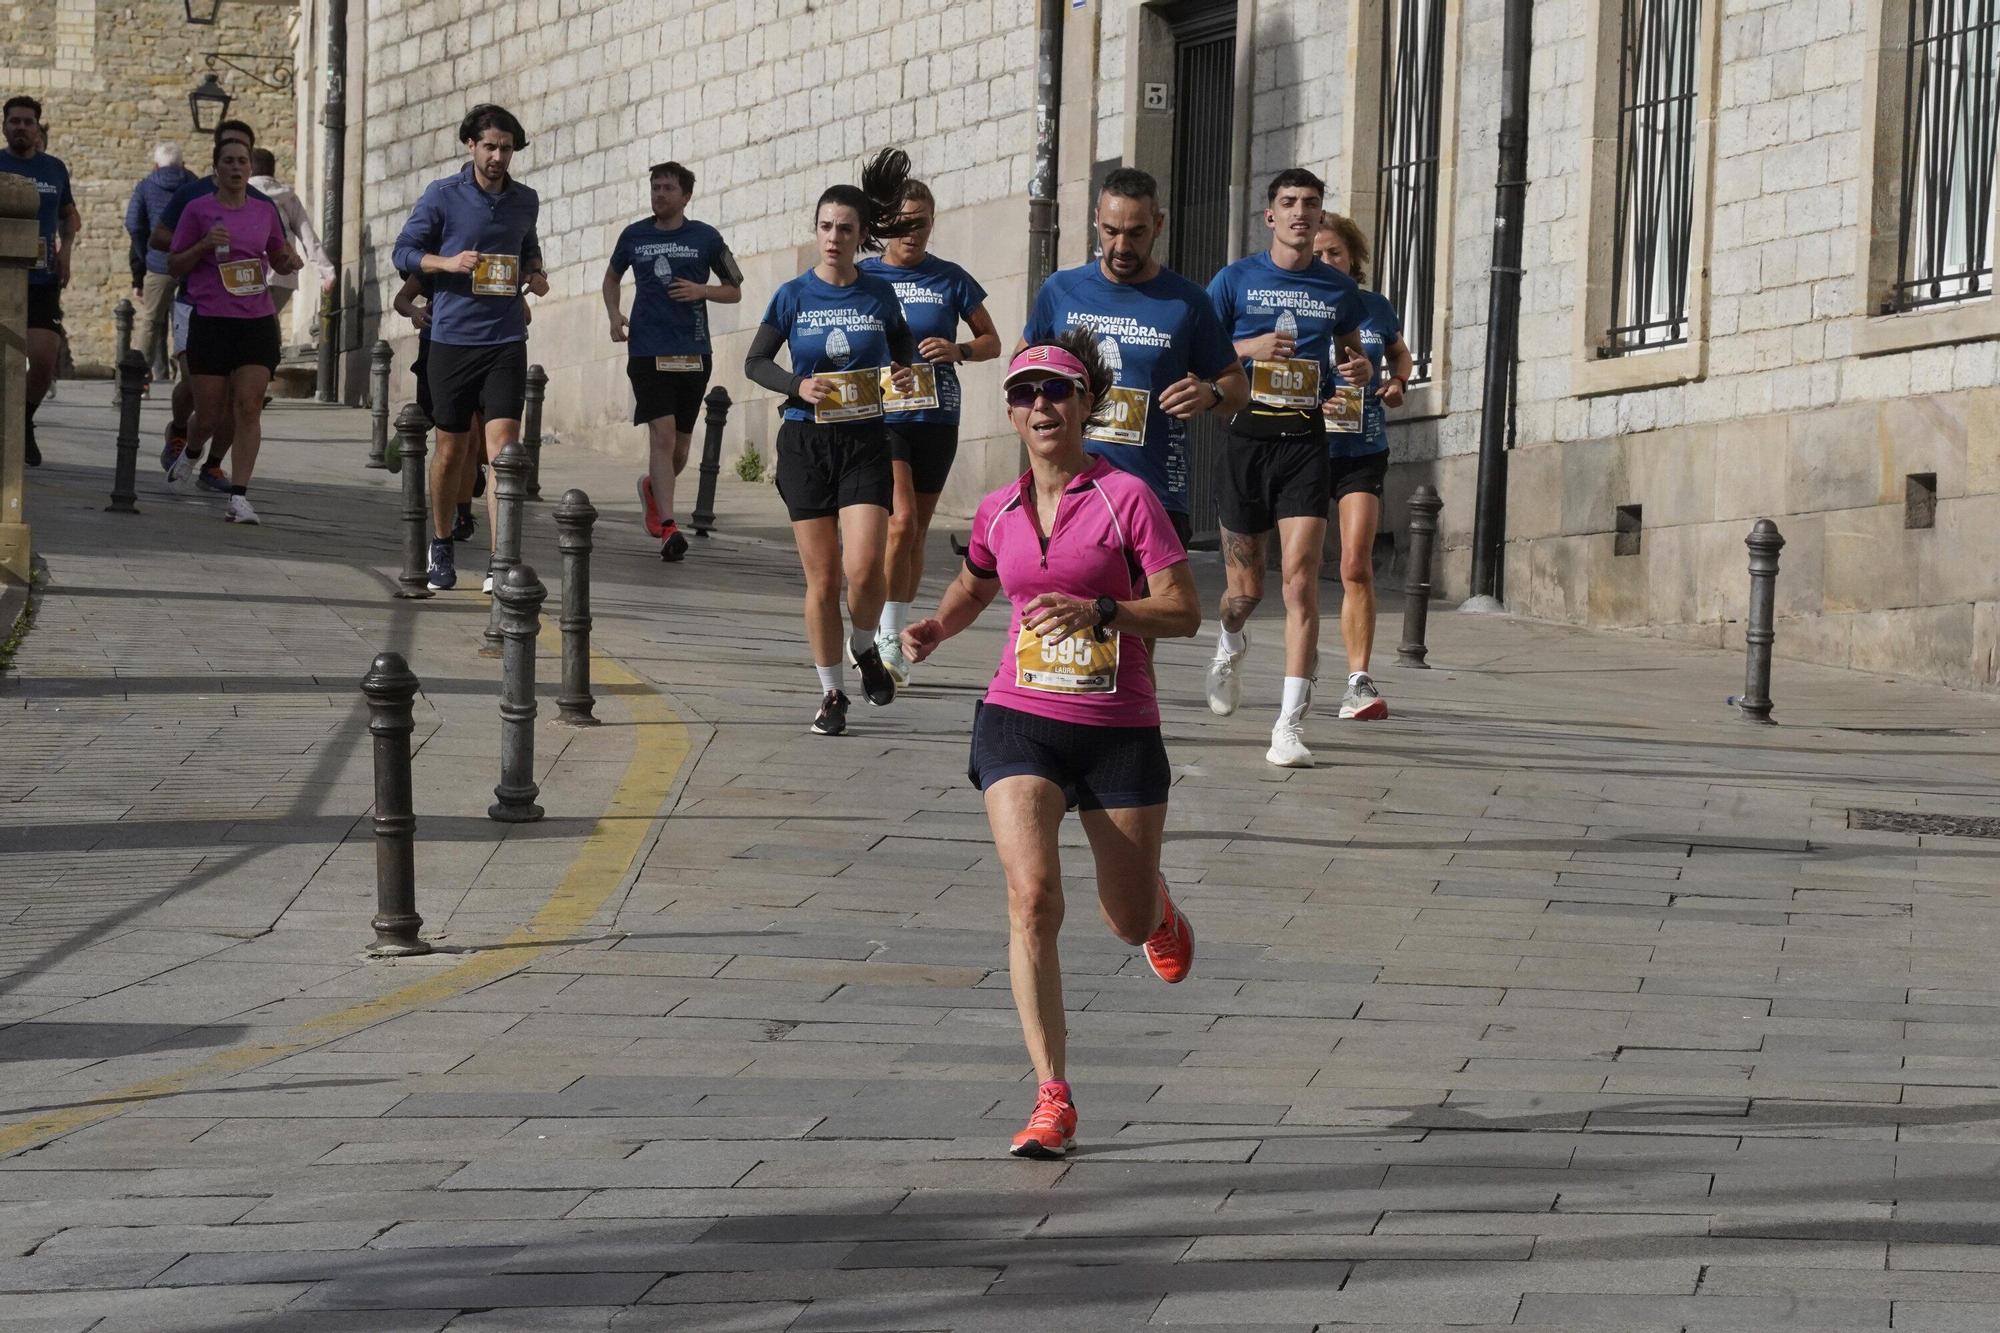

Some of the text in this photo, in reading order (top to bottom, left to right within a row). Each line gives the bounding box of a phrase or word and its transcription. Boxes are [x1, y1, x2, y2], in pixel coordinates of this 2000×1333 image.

[643, 245, 690, 256] ALMENDRA
[1258, 289, 1310, 300] CONQUISTA
[903, 296, 944, 305] KONKISTA
[1260, 297, 1327, 311] ALMENDRA
[797, 308, 859, 319] LA CONQUISTA
[1067, 312, 1138, 326] LA CONQUISTA
[1295, 308, 1336, 320] KONKISTA
[809, 314, 876, 328] ALMENDRA
[846, 323, 884, 332] KONKISTA
[1158, 332, 1172, 340] REN
[1120, 335, 1172, 349] KONKISTA
[1270, 369, 1304, 391] 603
[1041, 634, 1092, 666] 595
[1054, 666, 1076, 674] LAURA
